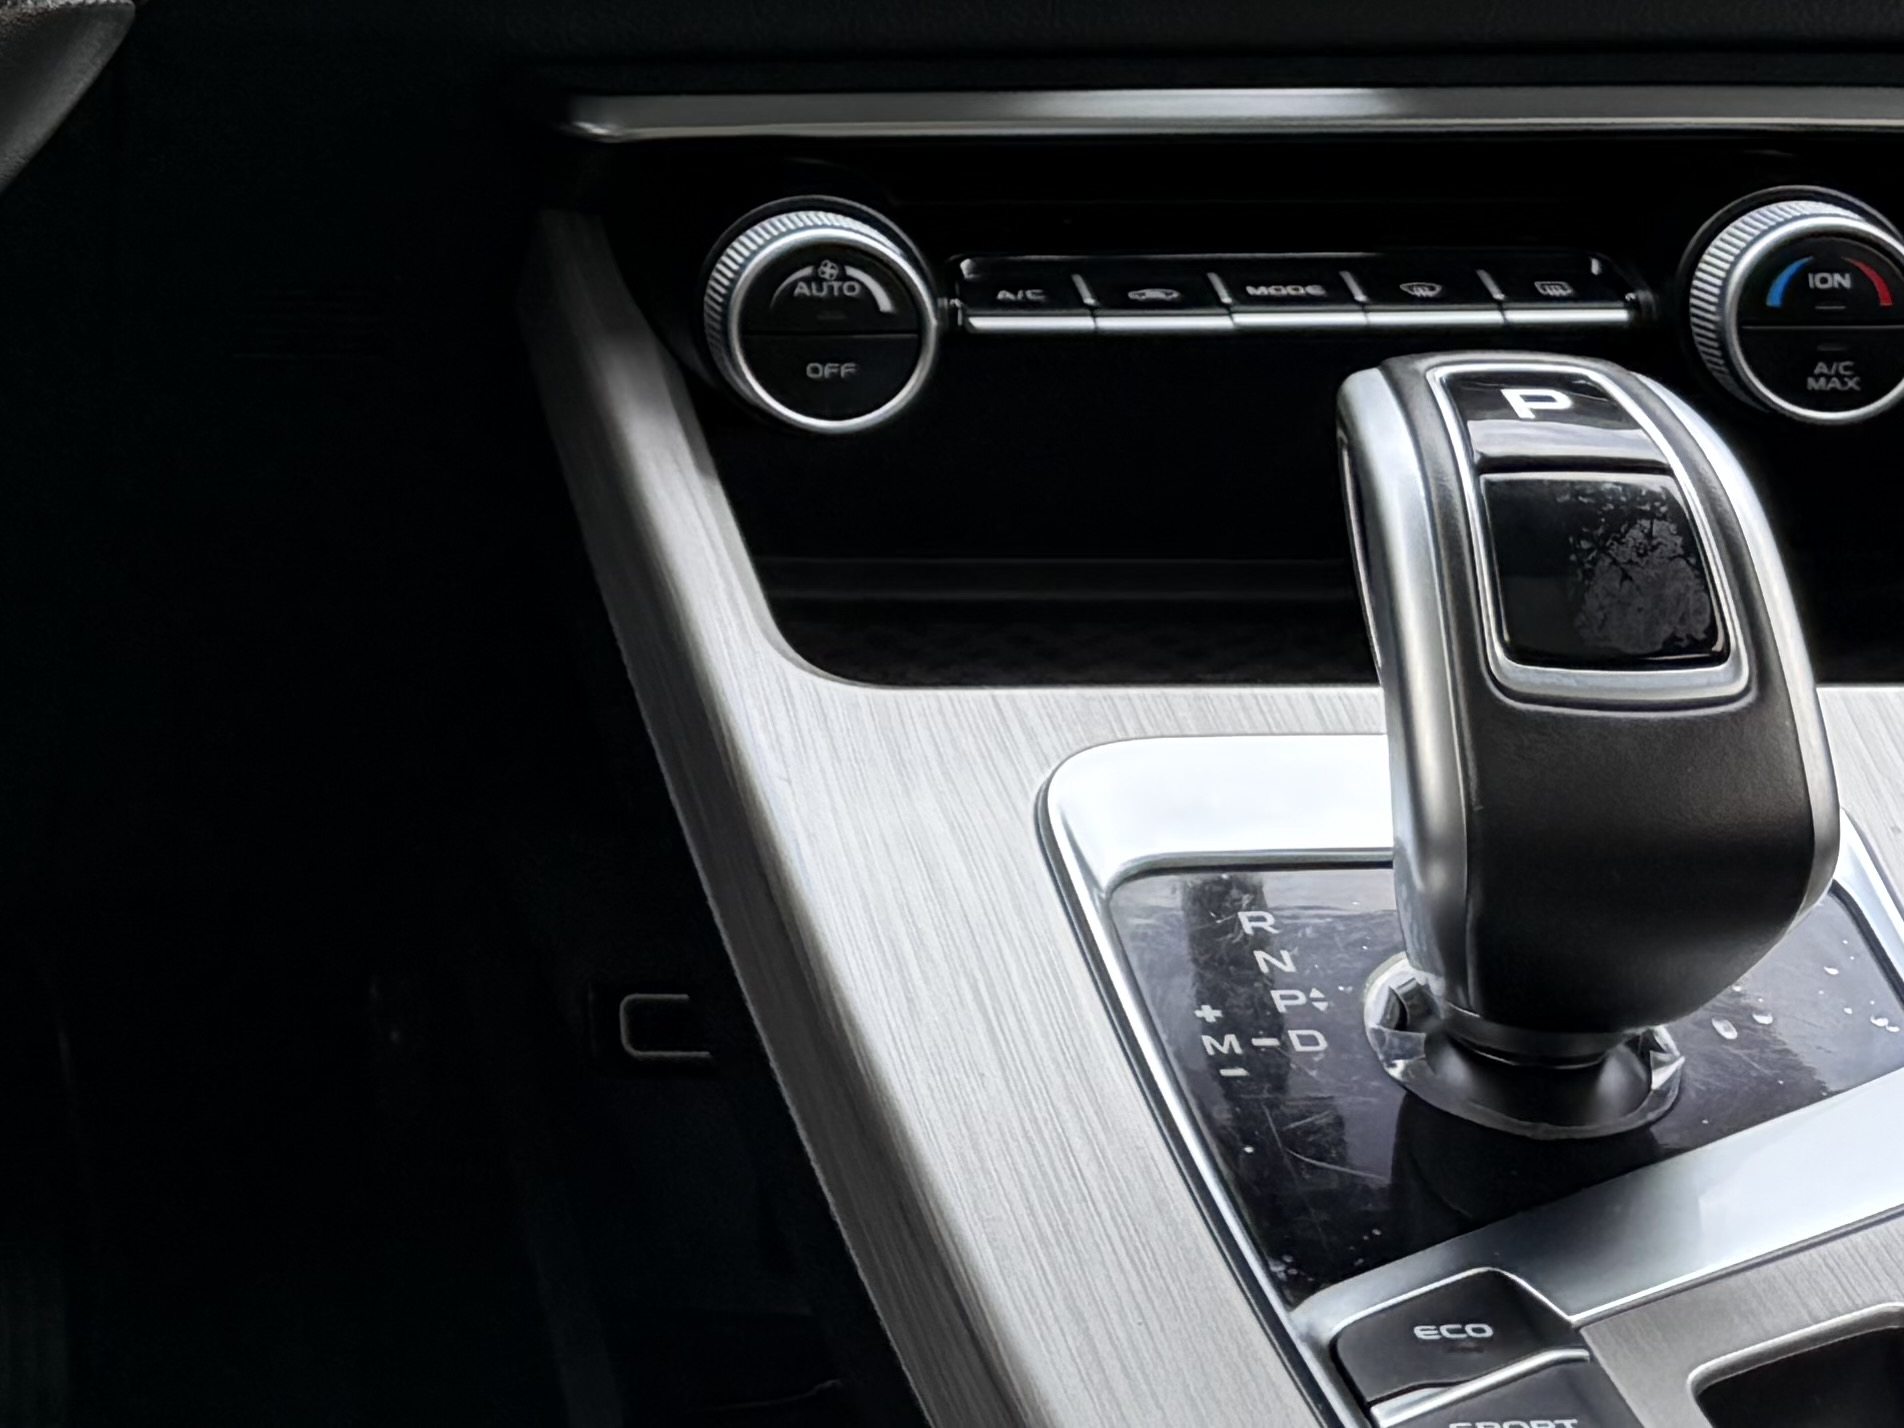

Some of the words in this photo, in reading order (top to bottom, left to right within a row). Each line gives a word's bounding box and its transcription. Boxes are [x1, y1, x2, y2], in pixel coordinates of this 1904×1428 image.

[793, 280, 861, 297] AUTO
[1807, 272, 1852, 289] ION
[996, 288, 1046, 302] A/C
[1245, 284, 1326, 298] MODE
[806, 362, 858, 379] OFF
[1813, 361, 1854, 375] A/C
[1806, 376, 1861, 391] MAX
[1500, 388, 1573, 419] P
[1237, 910, 1280, 935] R
[1253, 950, 1296, 974] N
[1270, 989, 1307, 1013] P
[1413, 1323, 1493, 1340] ECO
